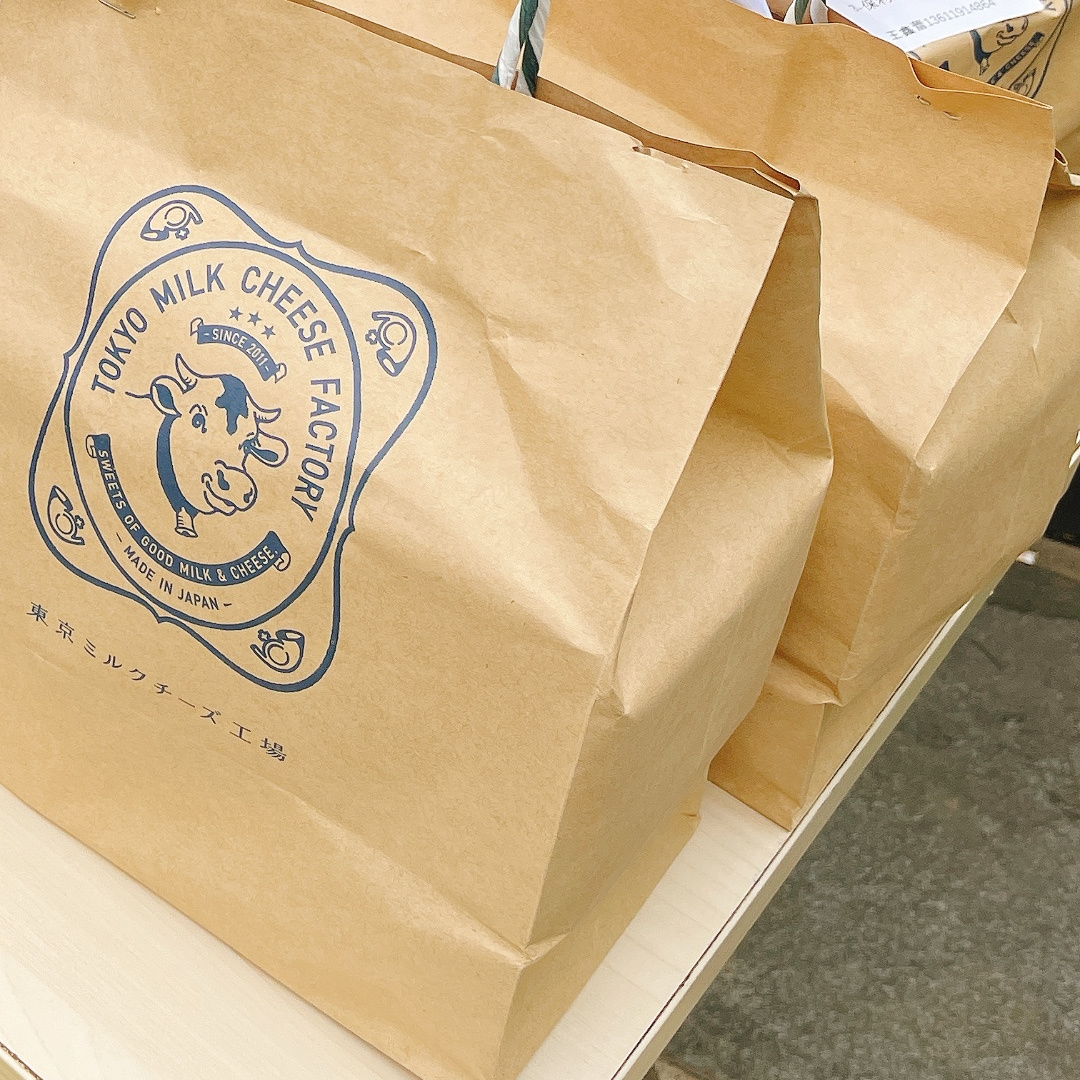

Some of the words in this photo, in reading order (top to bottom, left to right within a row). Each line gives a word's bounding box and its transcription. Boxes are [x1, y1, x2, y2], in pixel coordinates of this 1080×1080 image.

[91, 307, 148, 394] TOKYO
[149, 263, 226, 314] MILK
[241, 266, 337, 362] CHEESE
[291, 378, 341, 522] FACTORY
[212, 329, 246, 348] SINCE
[246, 342, 269, 367] 2011
[98, 450, 126, 510] SWEETS
[124, 514, 141, 533] OF
[141, 535, 174, 567] GOOD
[179, 562, 212, 582] MILK
[217, 569, 227, 582] &
[124, 545, 156, 581] MADE
[159, 578, 173, 595] IN
[177, 589, 219, 611] JAPAN
[26, 601, 287, 762] 東京ミルクチーズ工場
